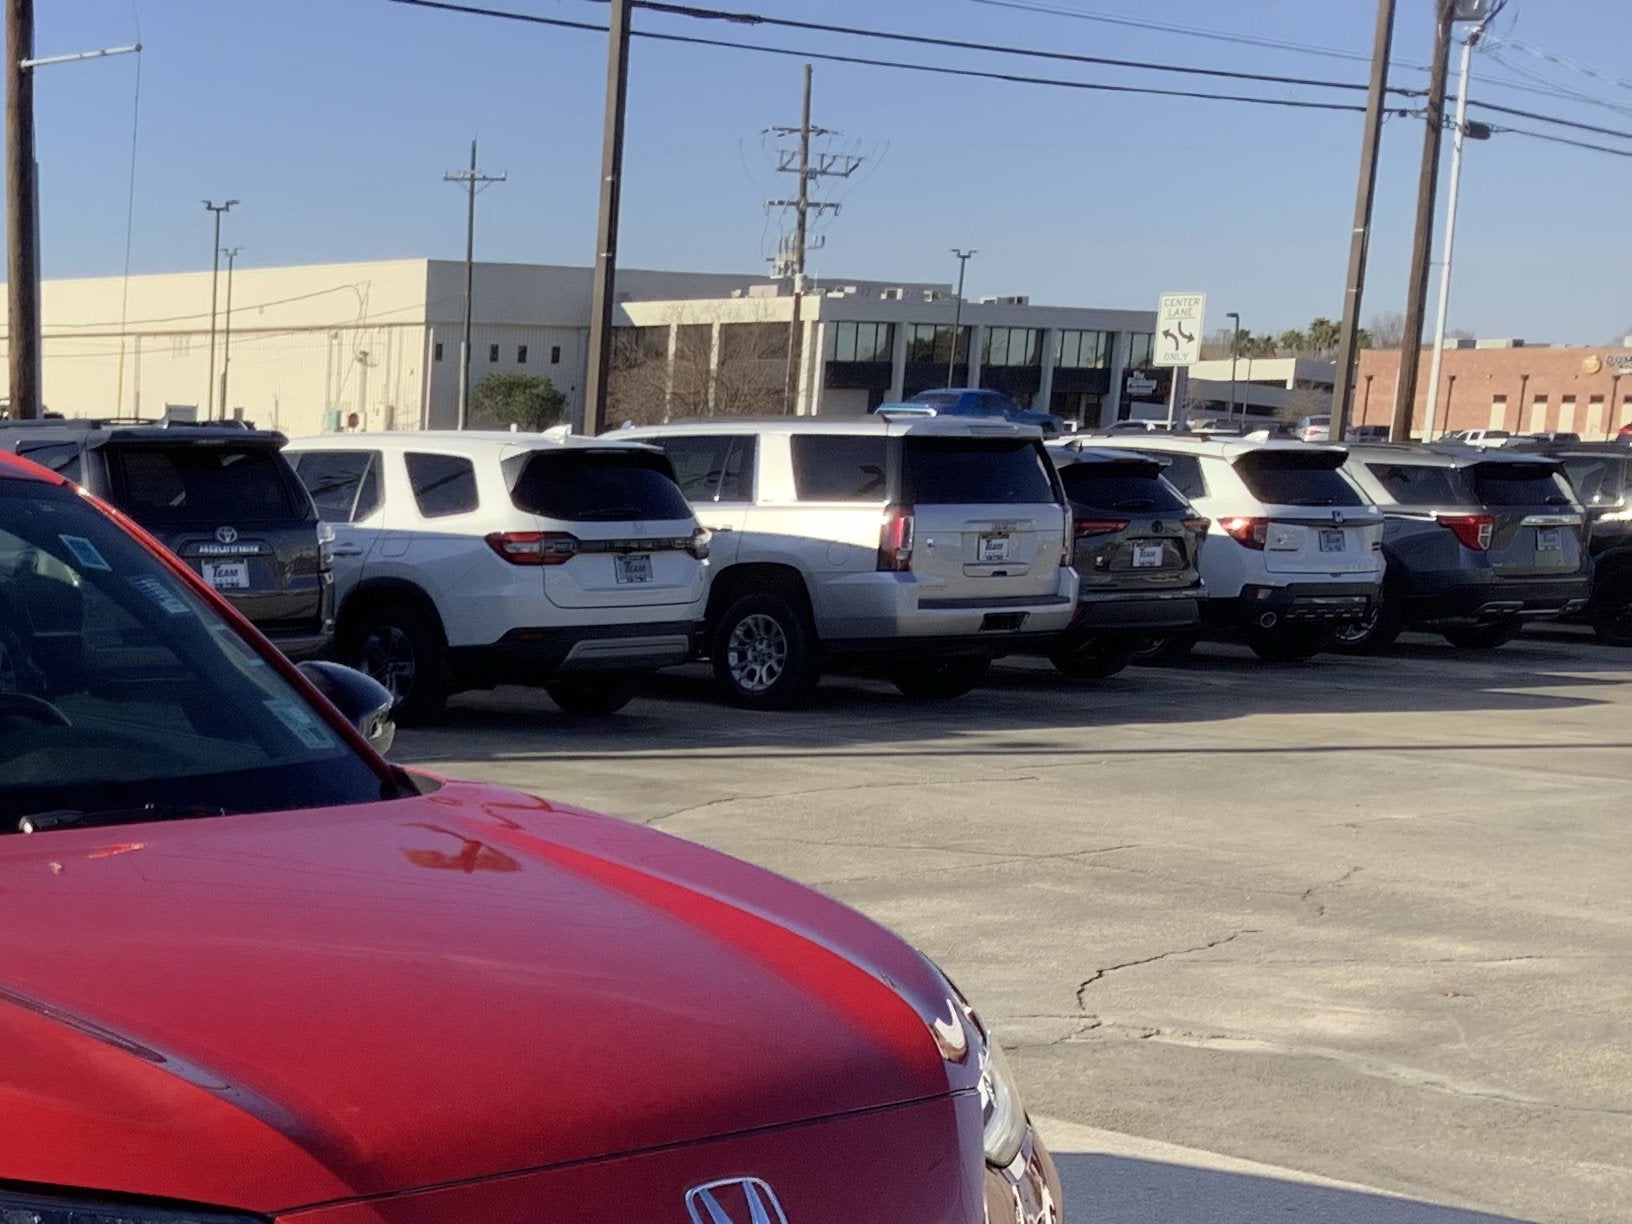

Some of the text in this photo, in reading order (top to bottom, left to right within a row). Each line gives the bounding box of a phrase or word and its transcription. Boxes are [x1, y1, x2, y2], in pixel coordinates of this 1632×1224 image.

[1163, 298, 1200, 308] CENTER
[1168, 308, 1194, 317] LANE
[1163, 352, 1189, 361] ONLY
